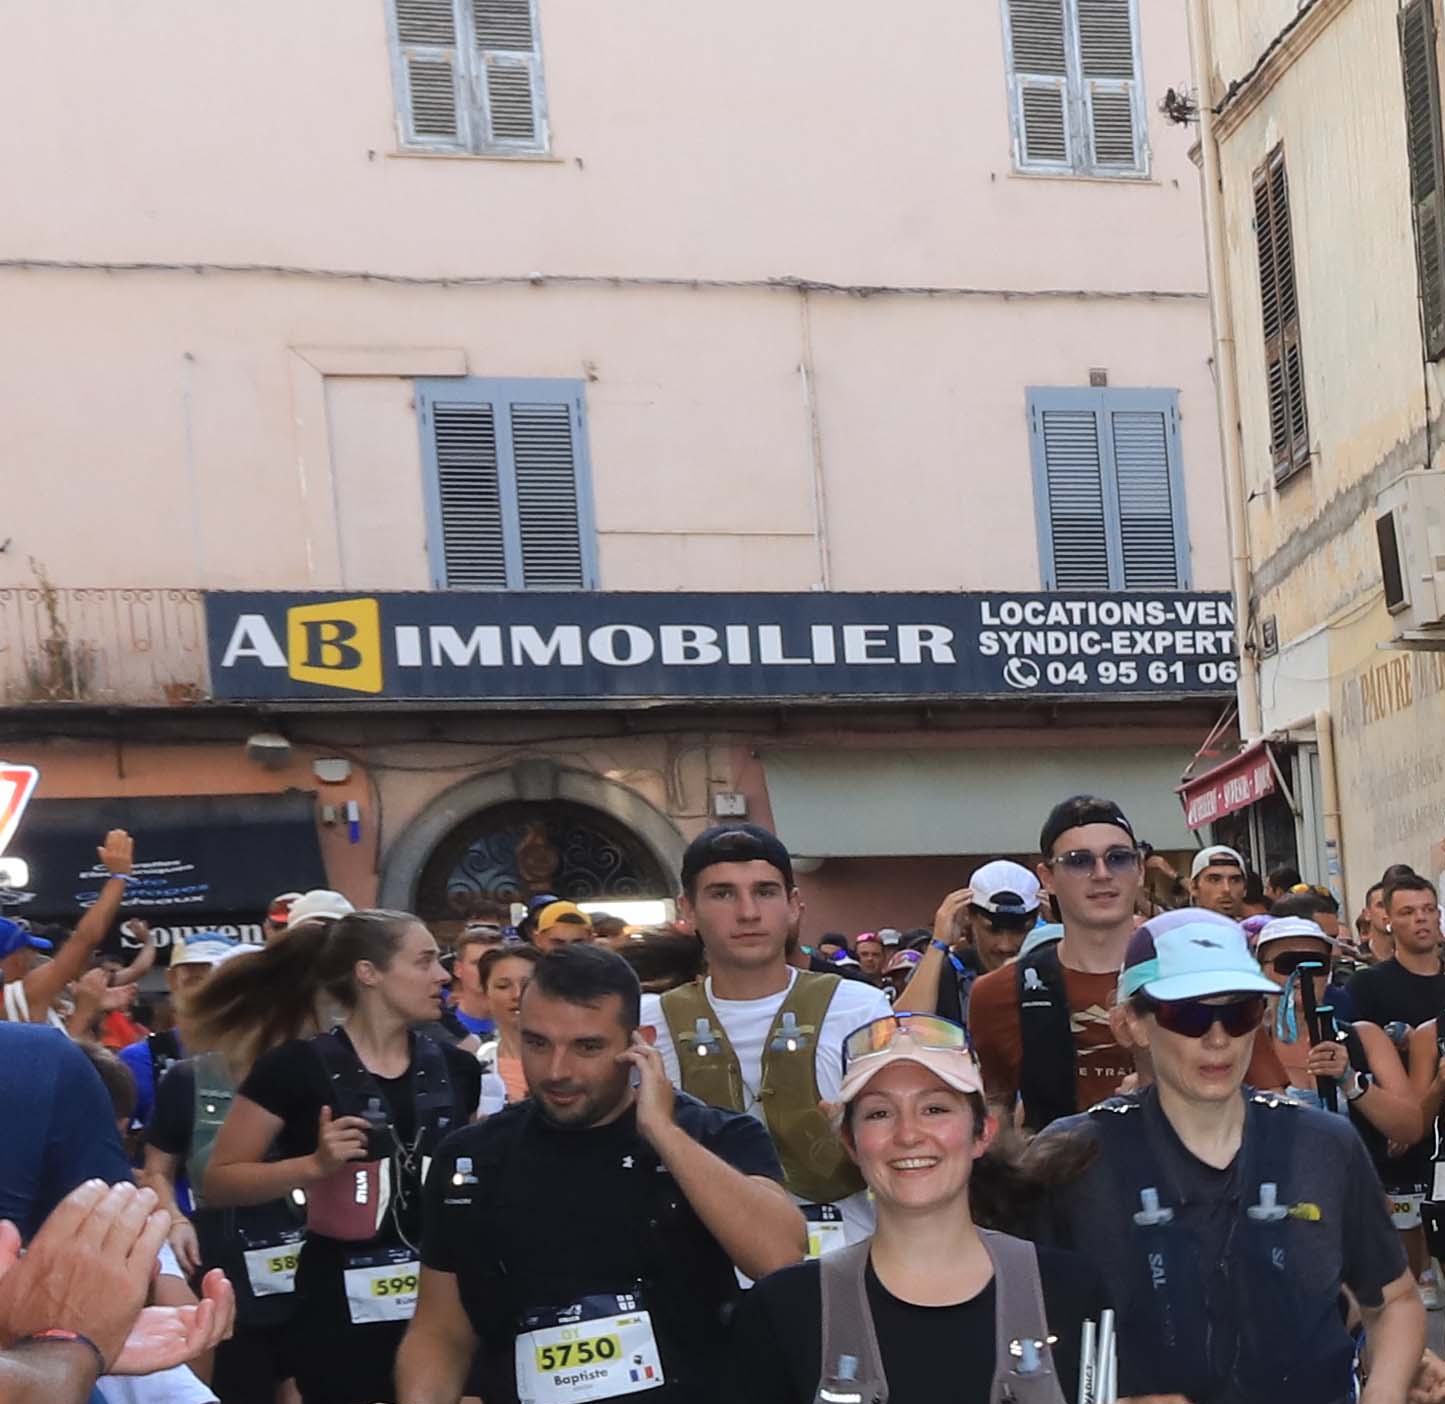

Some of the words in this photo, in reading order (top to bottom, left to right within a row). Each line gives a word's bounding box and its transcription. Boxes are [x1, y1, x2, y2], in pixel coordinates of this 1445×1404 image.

[395, 624, 956, 667] IMMOBILIER
[1047, 662, 1088, 685] 04
[1097, 662, 1138, 685] 95
[1149, 662, 1185, 685] 61
[1198, 662, 1238, 685] 06
[541, 1337, 615, 1370] 5750
[554, 1368, 608, 1386] Baptiste
